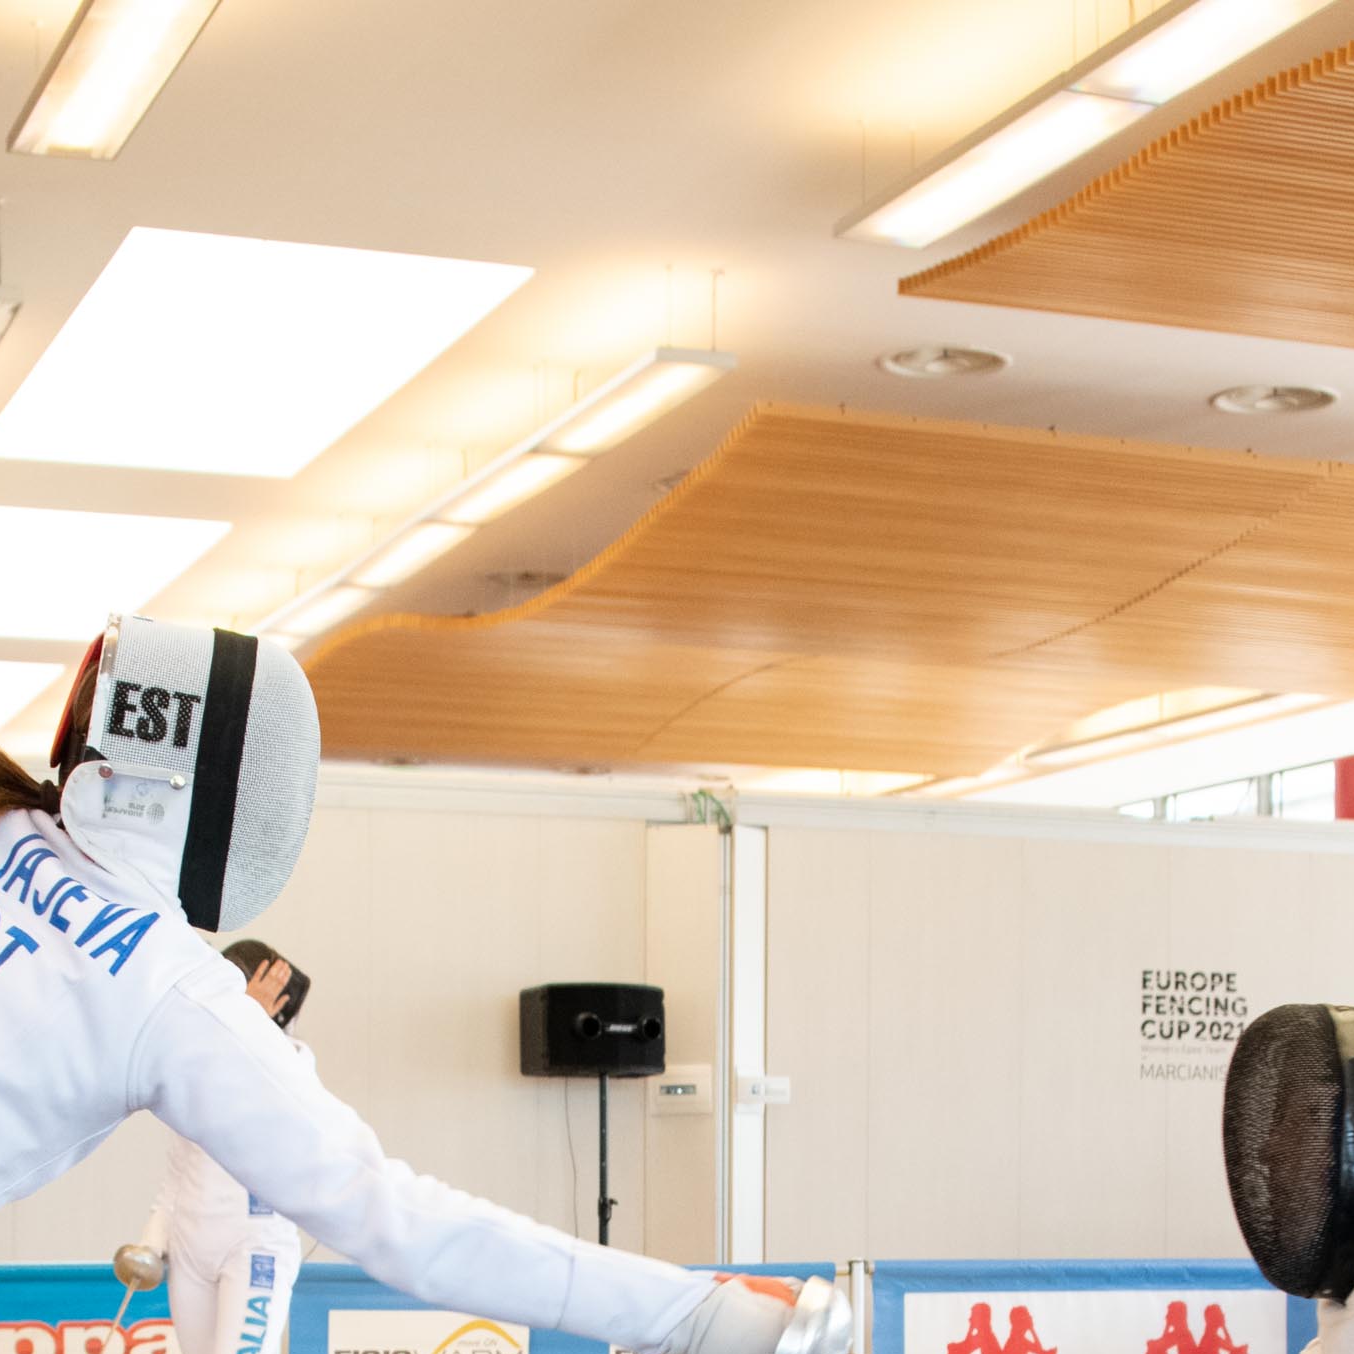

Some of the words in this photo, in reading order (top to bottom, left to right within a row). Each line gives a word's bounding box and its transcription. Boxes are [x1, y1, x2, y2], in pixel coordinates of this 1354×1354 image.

[108, 680, 202, 748] EST
[1141, 970, 1238, 993] EUROPE
[1141, 995, 1248, 1017] FENCING
[1140, 1019, 1191, 1040] CUP
[1140, 1063, 1228, 1081] MARCIANIS
